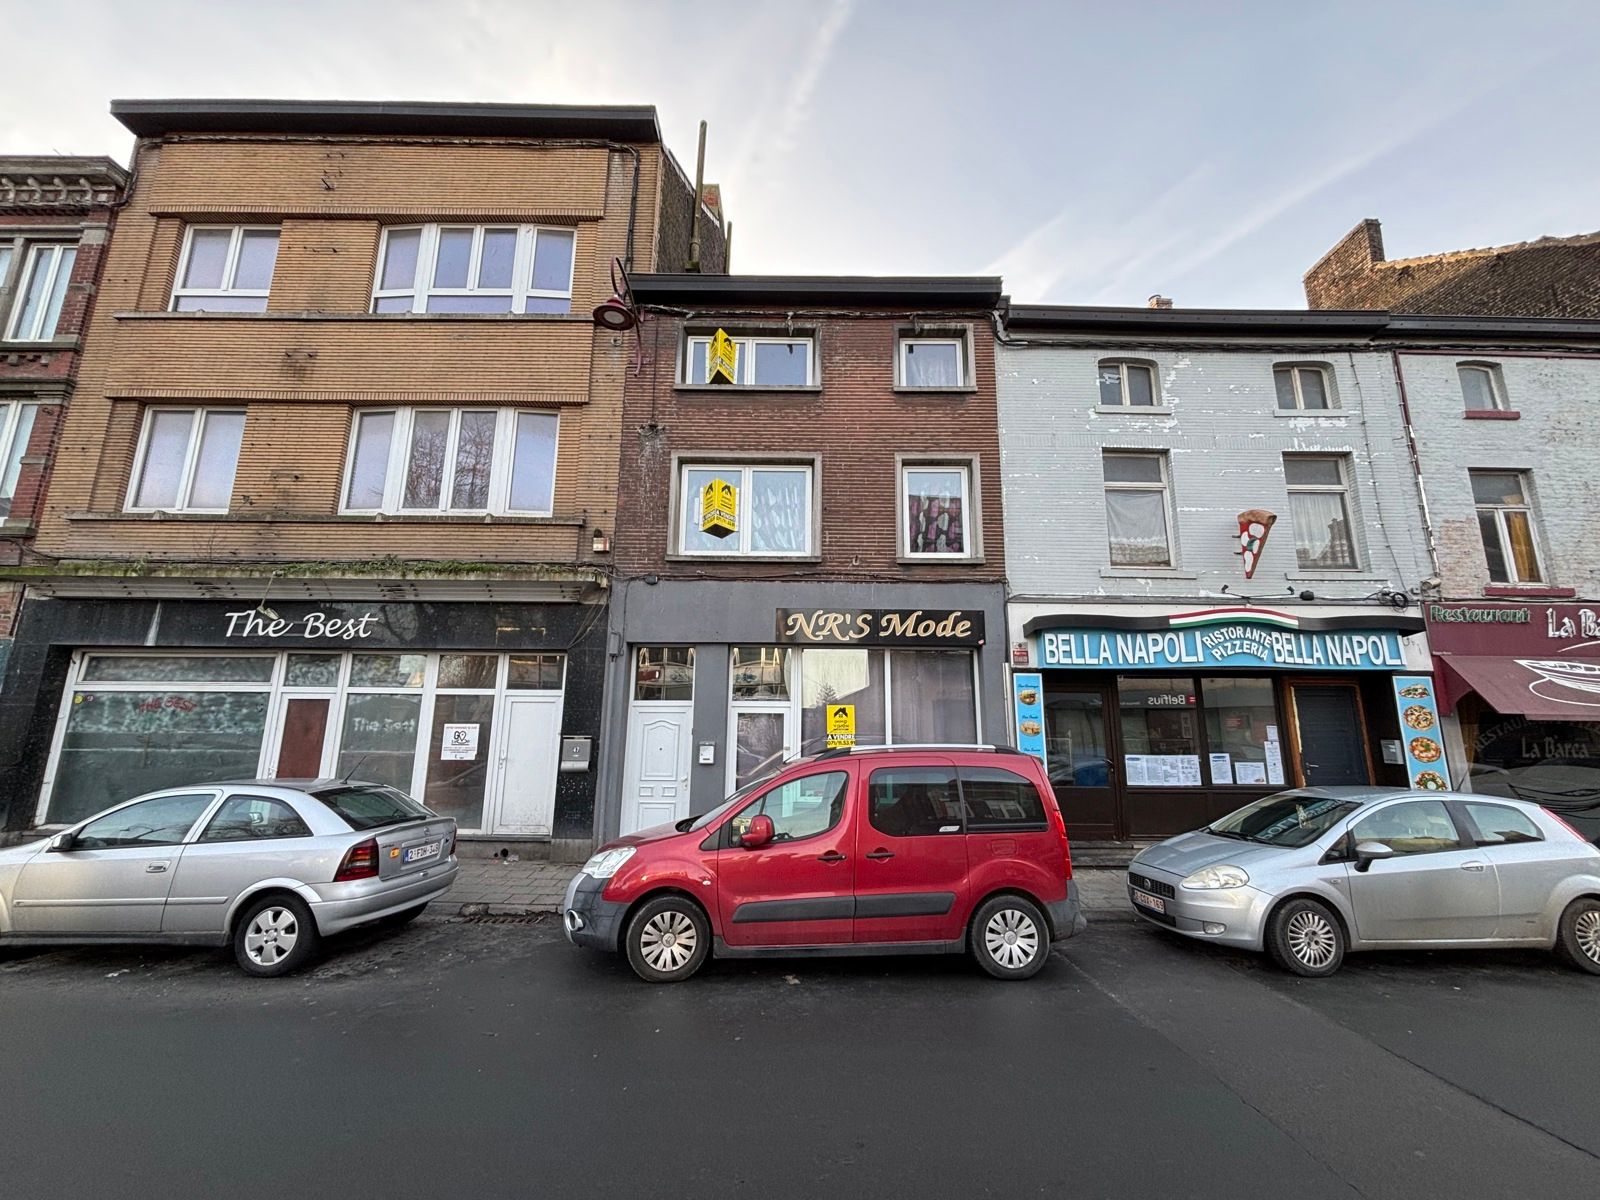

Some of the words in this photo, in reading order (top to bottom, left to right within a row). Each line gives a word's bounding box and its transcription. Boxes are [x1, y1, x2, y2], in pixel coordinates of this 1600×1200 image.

[225, 609, 293, 637] The
[303, 612, 379, 640] Best
[786, 610, 872, 641] NR'S
[879, 610, 971, 637] Mode
[1430, 605, 1530, 624] Restaurant
[1546, 608, 1576, 638] La
[1044, 633, 1113, 665] BELLA
[1116, 631, 1204, 664] NAPOLI
[1202, 626, 1272, 648] RISTORANTE
[1212, 640, 1269, 661] PIZZERIA
[1271, 632, 1325, 665] BELLA
[1325, 634, 1408, 665] NAPOLI
[1521, 736, 1540, 758] La
[1543, 735, 1589, 758] Barca
